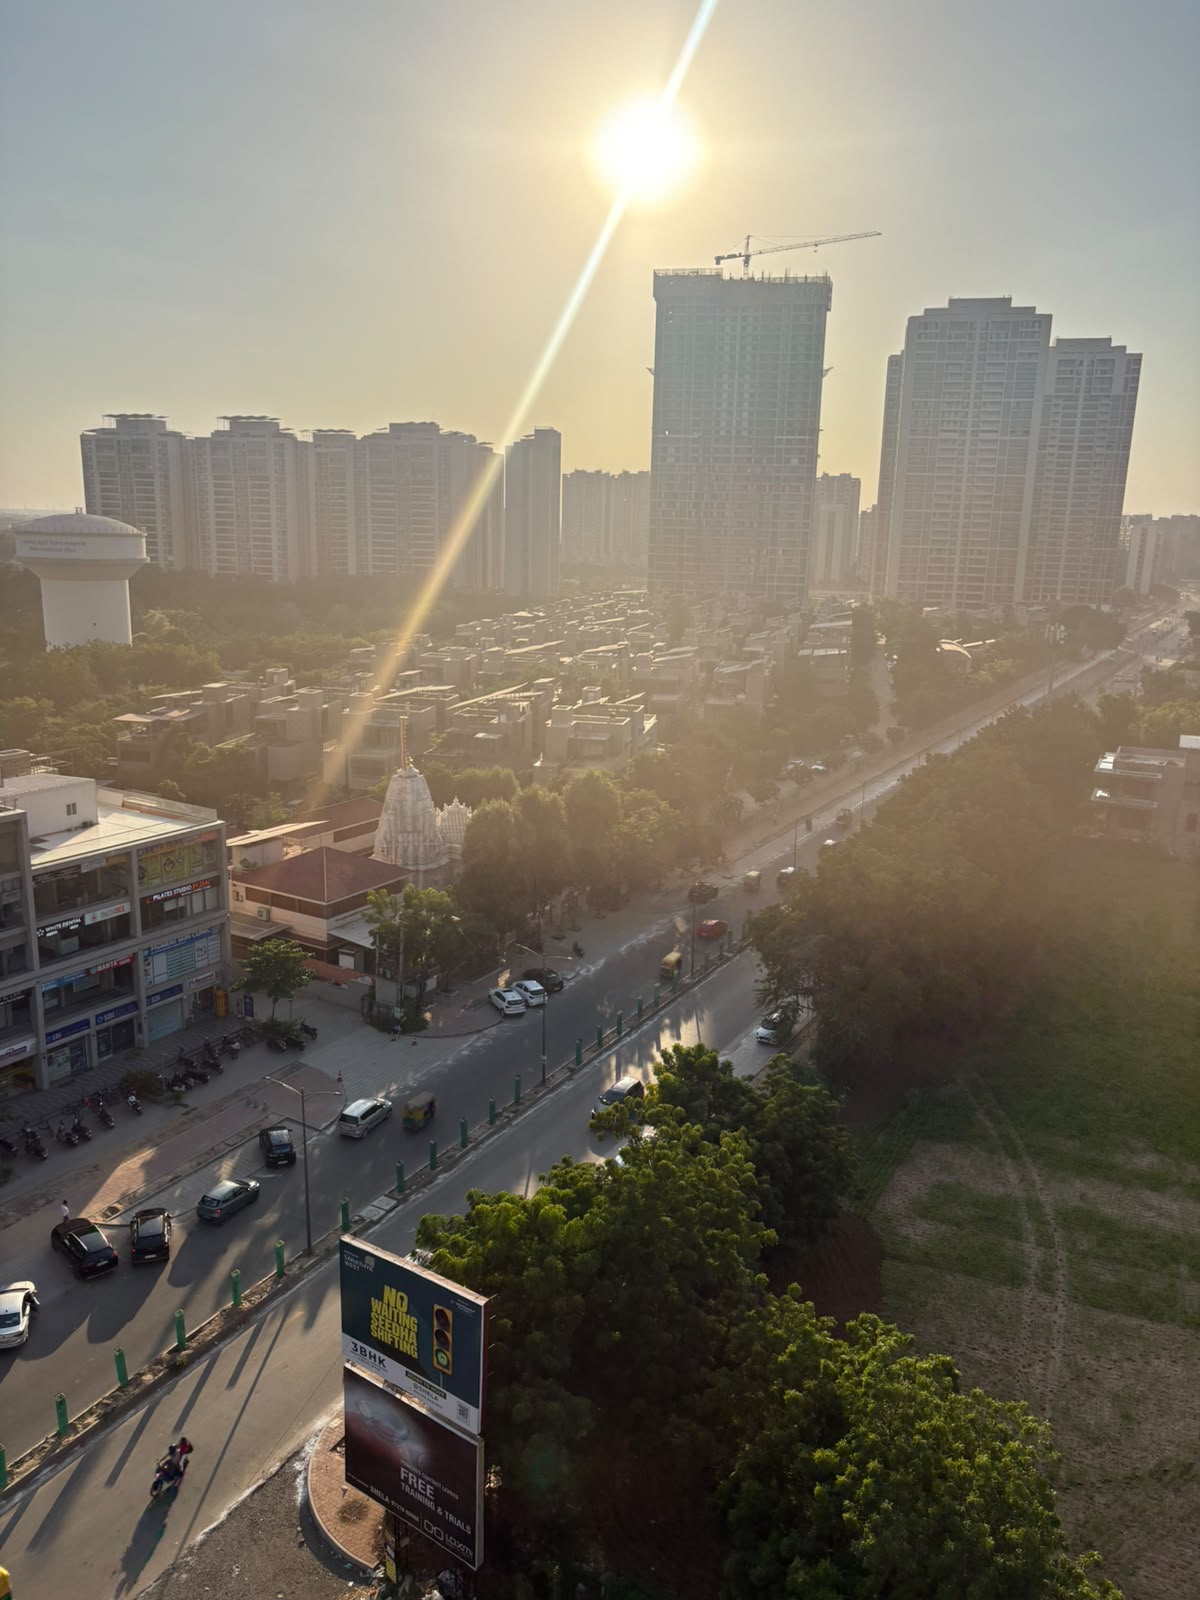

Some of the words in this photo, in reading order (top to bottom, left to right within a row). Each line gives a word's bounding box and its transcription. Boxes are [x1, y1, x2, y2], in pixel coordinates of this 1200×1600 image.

[173, 885, 192, 895] STUDIO
[45, 923, 62, 933] WHITE
[103, 1011, 115, 1022] SBI
[52, 1032, 62, 1041] SBI
[383, 1284, 408, 1313] NO
[371, 1297, 418, 1332] WAITING
[371, 1312, 418, 1345] SEEDHA
[351, 1341, 386, 1368] 3BHK
[370, 1324, 418, 1359] SHIFTING
[370, 1485, 390, 1503] SHELA
[400, 1467, 435, 1500] FREE
[401, 1482, 436, 1511] TRAINING
[436, 1506, 443, 1516] &
[445, 1510, 472, 1535] TRIALS
